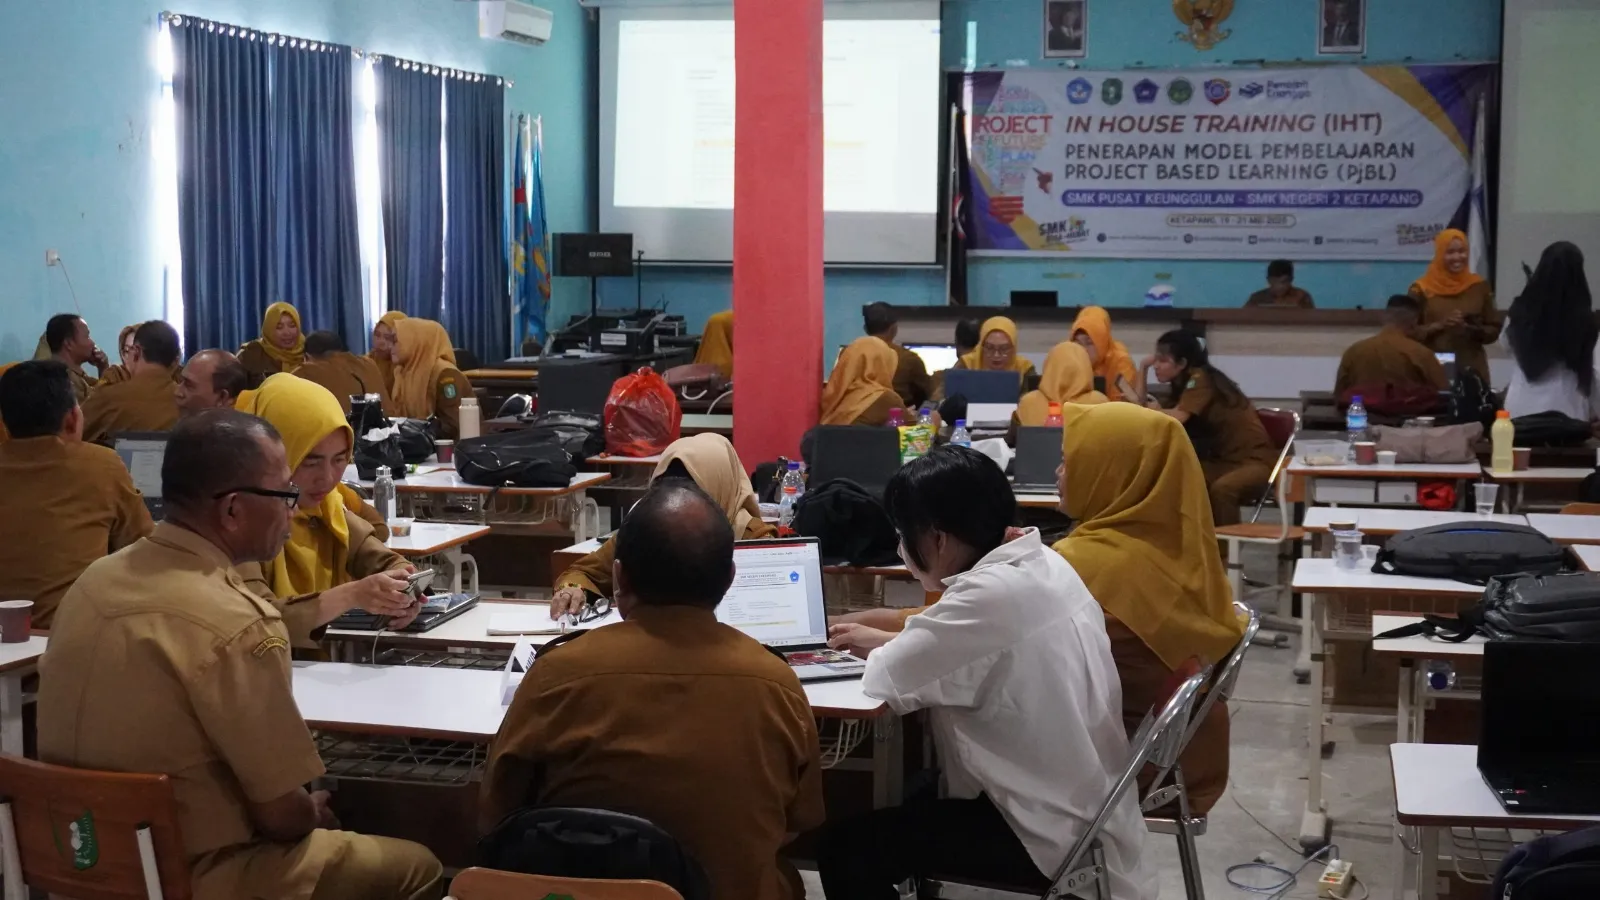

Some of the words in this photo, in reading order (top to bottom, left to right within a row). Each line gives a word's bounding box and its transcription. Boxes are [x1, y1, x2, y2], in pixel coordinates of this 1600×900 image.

[1066, 115, 1092, 133] IN
[1101, 115, 1185, 133] HOUSE
[1193, 114, 1316, 133] TRAINING
[1324, 113, 1382, 135] (IHT)
[1066, 144, 1175, 159] PENERAPAN
[1185, 144, 1253, 159] MODEL
[1262, 142, 1415, 159] PEMBELAJARAN
[1065, 164, 1148, 180] PROJECT
[1156, 164, 1220, 180] BASED
[1229, 164, 1329, 180] LEARNING
[1337, 163, 1397, 184] (PjBL)
[1066, 193, 1095, 205] SMK
[1098, 193, 1141, 205] PUSAT
[1145, 193, 1235, 205] KEUNGGULAN
[1248, 193, 1279, 205] SMK
[1280, 193, 1330, 205] NEGERI
[1332, 193, 1342, 205] 2
[1344, 193, 1420, 206] KETAPANG
[1039, 219, 1067, 236] SMK
